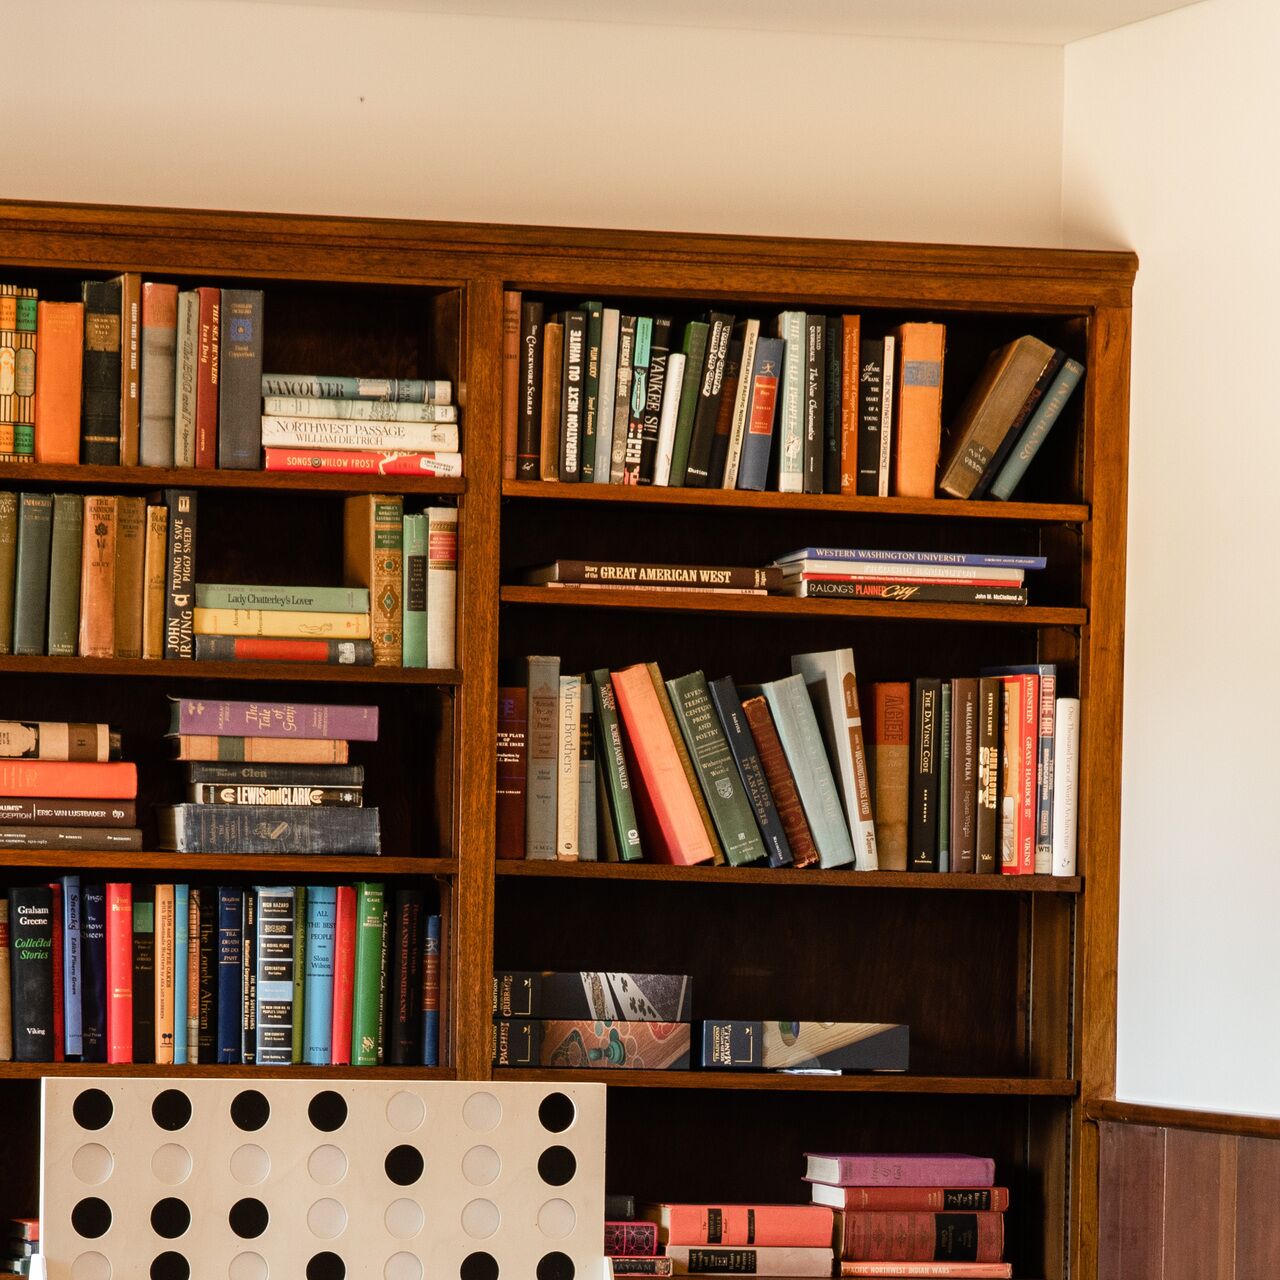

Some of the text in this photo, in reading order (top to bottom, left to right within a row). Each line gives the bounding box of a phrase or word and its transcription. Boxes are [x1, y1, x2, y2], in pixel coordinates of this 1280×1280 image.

[211, 303, 219, 321] THE
[209, 343, 218, 384] RUNNERS
[265, 379, 344, 398] VANCOUVER
[565, 329, 582, 473] GENERATION NEXT OLI WHITE
[643, 355, 666, 432] YANKEE SI!
[275, 419, 406, 437] NORTHWEST PASSAGE
[295, 433, 383, 446] WILLIAM DIETRICH
[286, 456, 375, 469] SONGS WILLOW FROST
[173, 518, 183, 590] TRYING TO SAVE
[182, 526, 192, 581] PIGGY SNEED
[599, 566, 731, 583] GREAT AMERICAN WEST
[227, 593, 314, 607] Lady Chatterley's Lover
[167, 617, 180, 652] JOHN
[179, 609, 193, 659] IRVING
[600, 686, 609, 709] MUSIC
[245, 704, 297, 731] The Tale of Genji
[884, 695, 904, 741] AGEE
[609, 723, 628, 789] ROBERT JAMES WALLER
[748, 755, 770, 807] METHODS
[1023, 679, 1033, 866] WEINSTEIN GRAYS HARBOR VIKING
[742, 758, 769, 826] IN ANALYSIS
[36, 809, 106, 818] ERIC VAN LUSTBADER
[17, 905, 49, 914] Graham
[19, 916, 48, 926] Greene
[307, 921, 336, 929] THE BEST
[310, 933, 333, 941] PEOPLE
[14, 938, 51, 949] Collected
[19, 949, 48, 960] Stories
[310, 961, 331, 970] Wilson
[312, 954, 330, 962] Sloan
[399, 903, 410, 1022] WAR AND REMEMBRANCE
[198, 923, 213, 1030] The Lonely African
[502, 974, 512, 1016] CRIBBAGE
[26, 1026, 46, 1036] Viking
[499, 1021, 509, 1064] PACHISI
[723, 1023, 731, 1064] MANCALA
